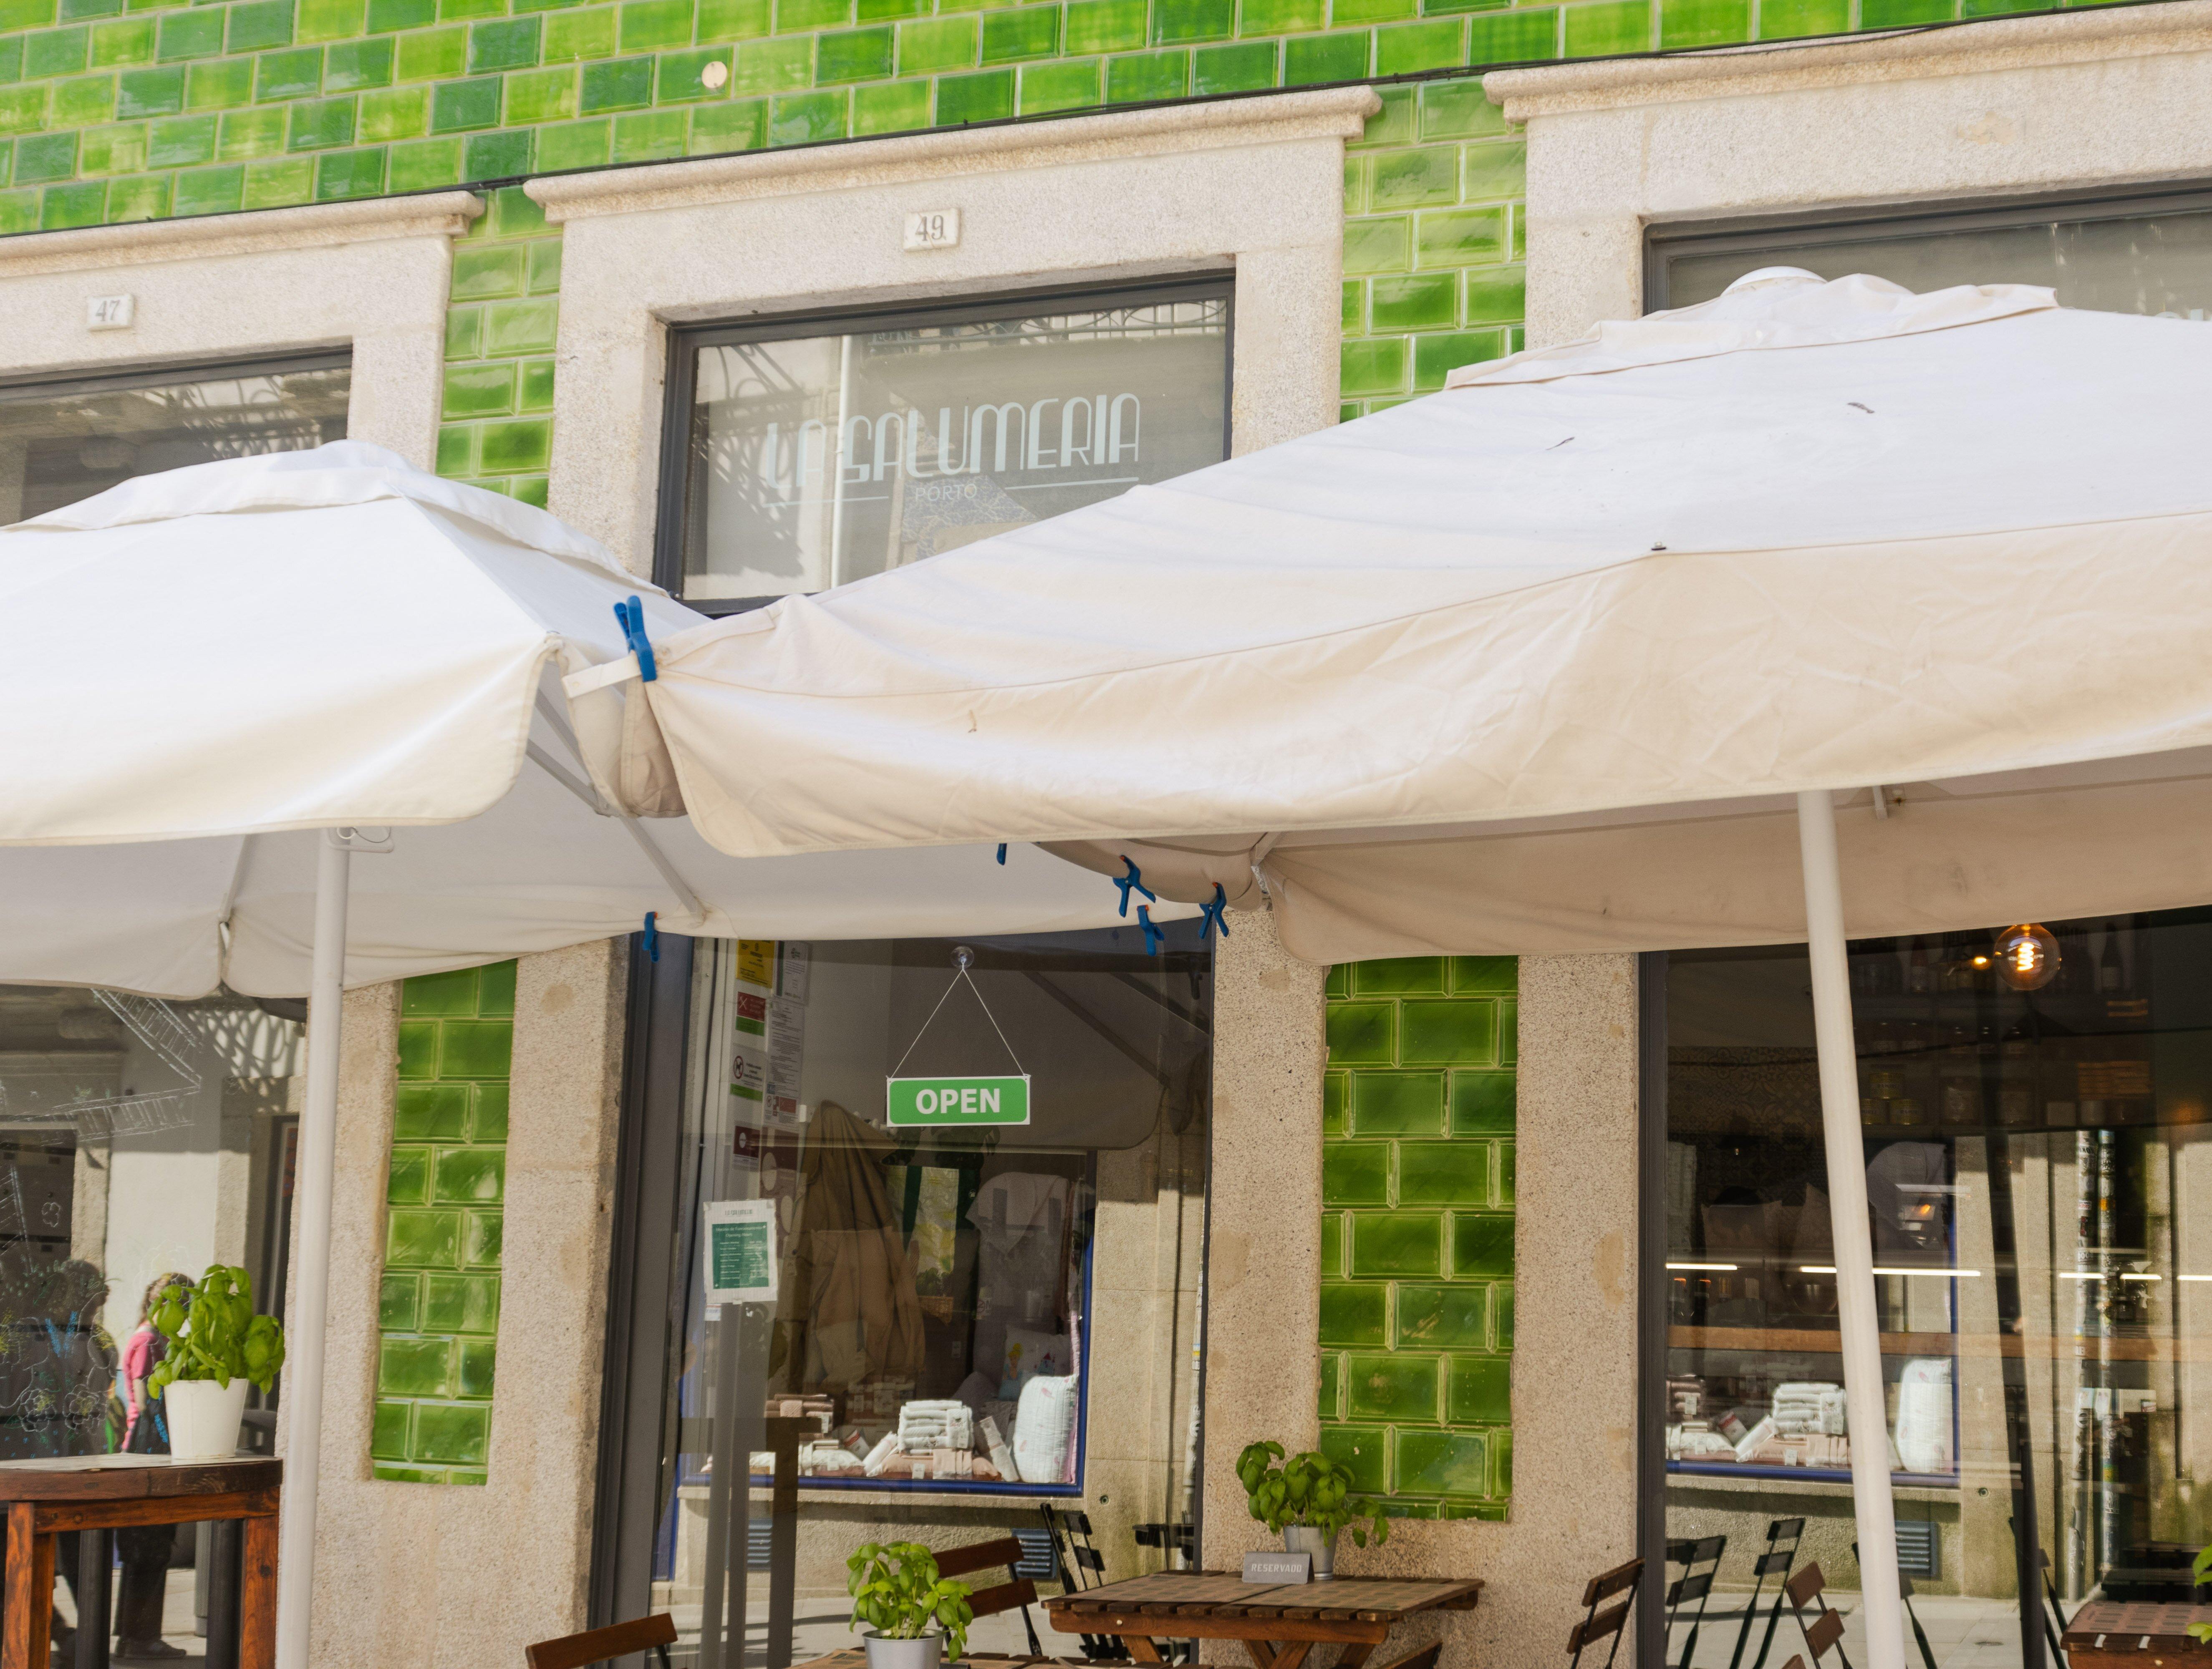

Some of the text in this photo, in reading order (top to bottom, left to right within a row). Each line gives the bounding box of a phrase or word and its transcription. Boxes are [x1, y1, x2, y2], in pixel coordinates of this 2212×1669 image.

[915, 214, 944, 241] 49
[95, 299, 120, 321] 47
[766, 393, 1141, 489] LA SALUMERIA
[916, 483, 977, 501] PORTO
[916, 1088, 1000, 1114] OPEN
[1251, 1564, 1302, 1573] RESERVADO
